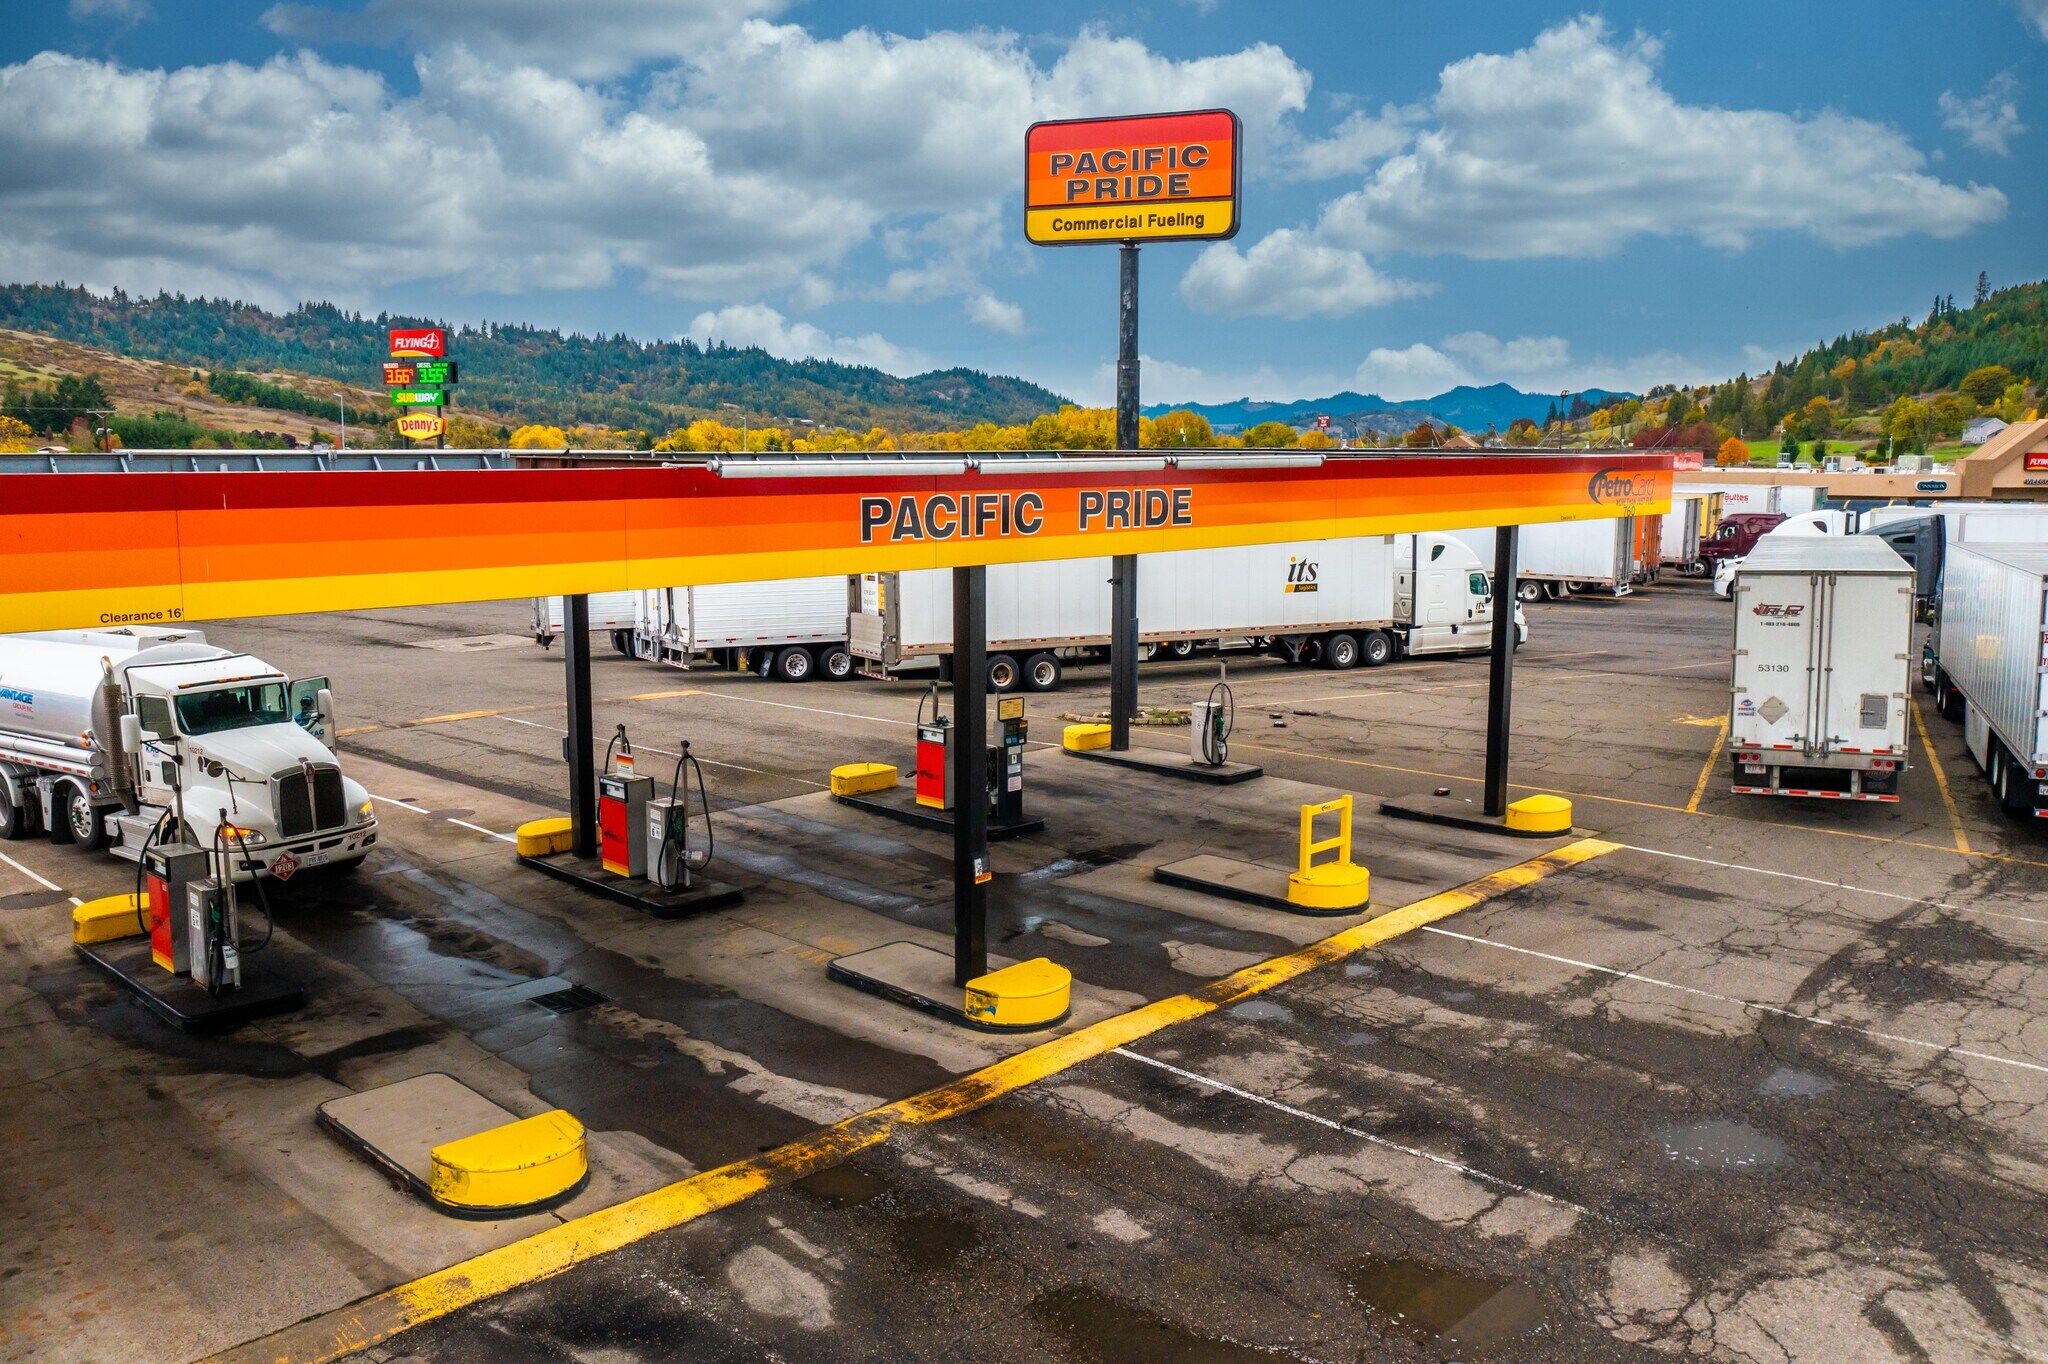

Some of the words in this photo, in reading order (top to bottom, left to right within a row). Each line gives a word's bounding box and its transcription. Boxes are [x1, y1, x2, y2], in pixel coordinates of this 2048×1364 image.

[1050, 144, 1209, 177] PACIFIC
[1066, 172, 1191, 202] PRIDE
[1052, 214, 1142, 231] Commercial
[1147, 212, 1205, 229] Fueling
[395, 338, 426, 348] FLYING
[396, 393, 439, 403] SUBWAY
[401, 419, 439, 432] Denny's
[1724, 493, 1749, 501] Buttes
[860, 492, 1044, 543] PACIFIC
[1078, 487, 1193, 531] PRIDE
[1288, 556, 1319, 582] its
[100, 610, 163, 623] Clearance
[1758, 664, 1789, 672] 53130
[348, 831, 366, 840] 10212
[275, 862, 293, 873] 1203
